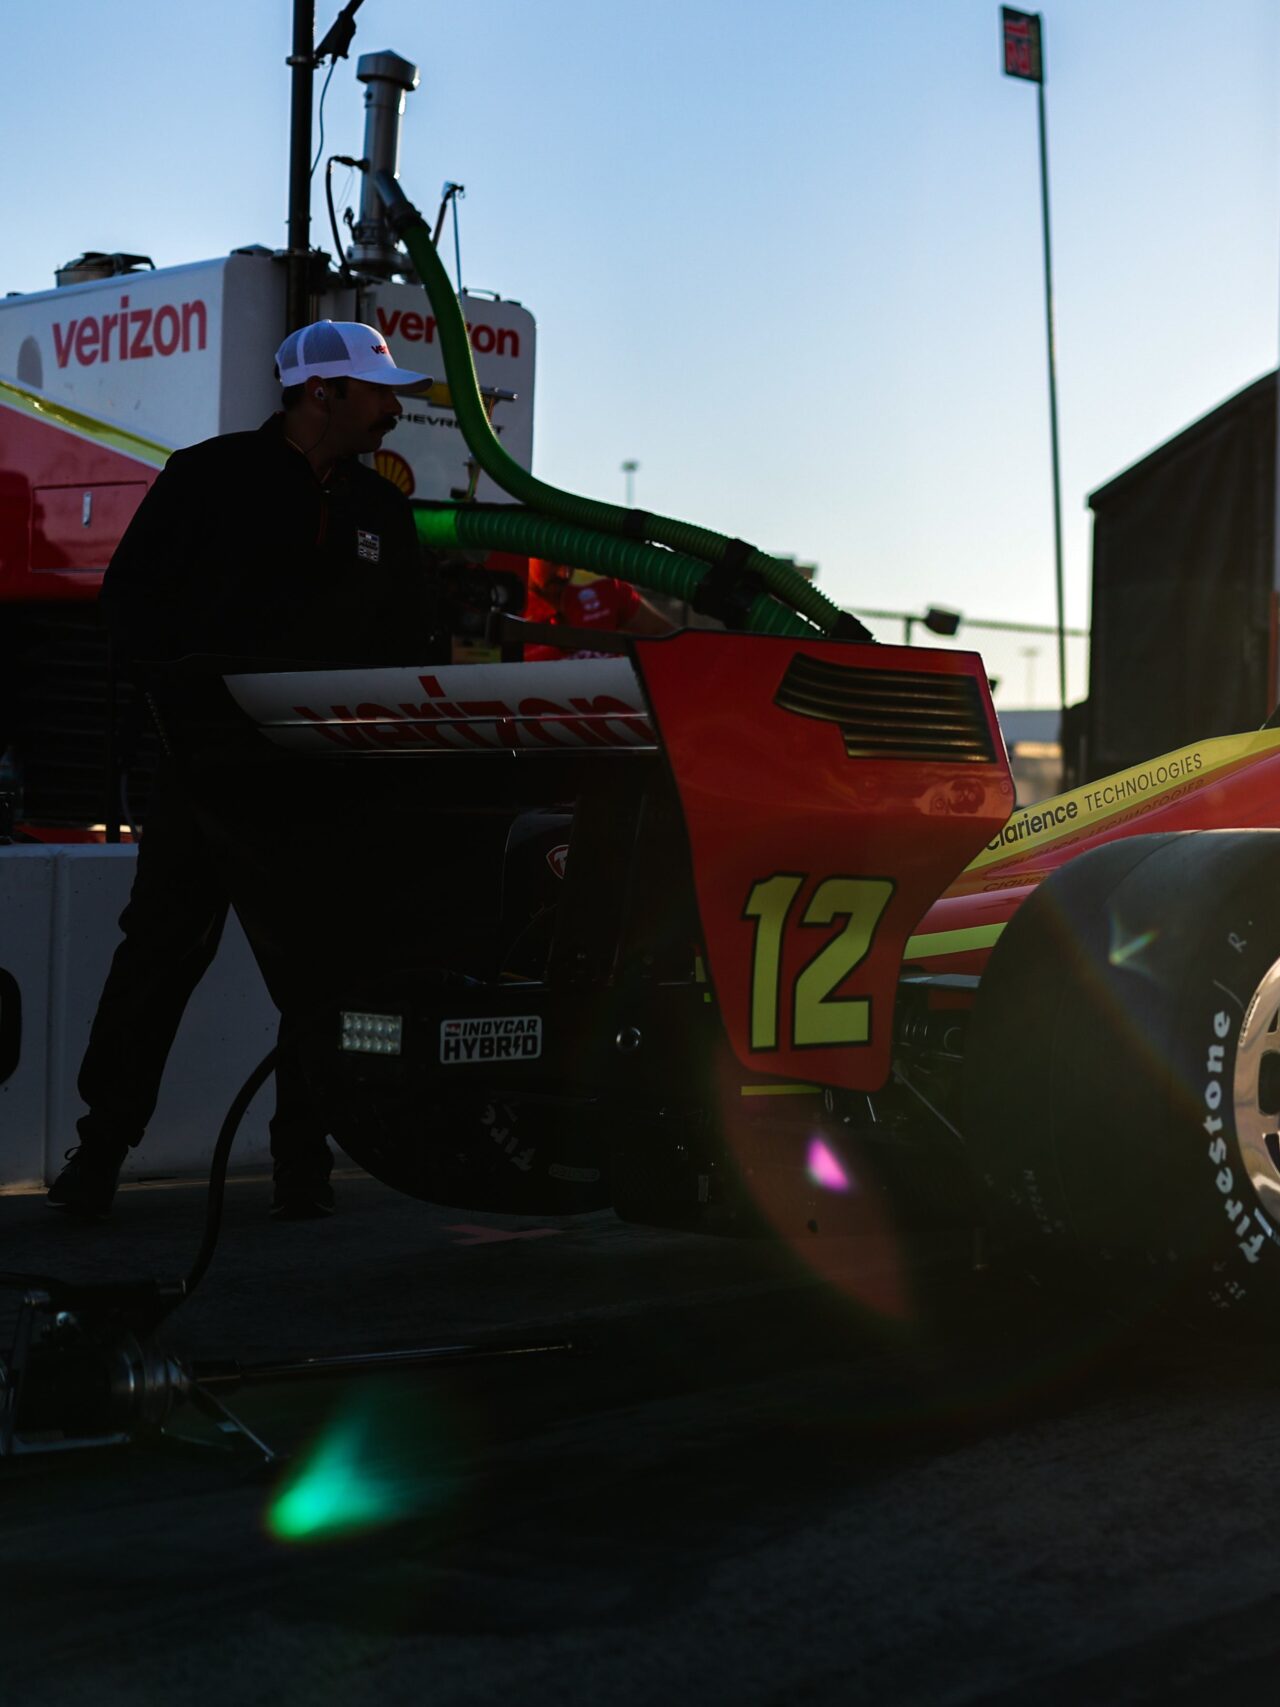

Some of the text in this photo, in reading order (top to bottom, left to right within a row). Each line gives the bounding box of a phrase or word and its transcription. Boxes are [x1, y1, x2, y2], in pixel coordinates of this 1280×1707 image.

[52, 295, 207, 369] verizon
[376, 307, 520, 359] veron
[293, 675, 657, 749] verizon
[1084, 753, 1203, 812] TECHNOLOGIES
[741, 870, 897, 1054] 12
[444, 1035, 537, 1060] HYBRID
[462, 1019, 538, 1036] INDYCAR
[1203, 1009, 1266, 1264] Firestone
